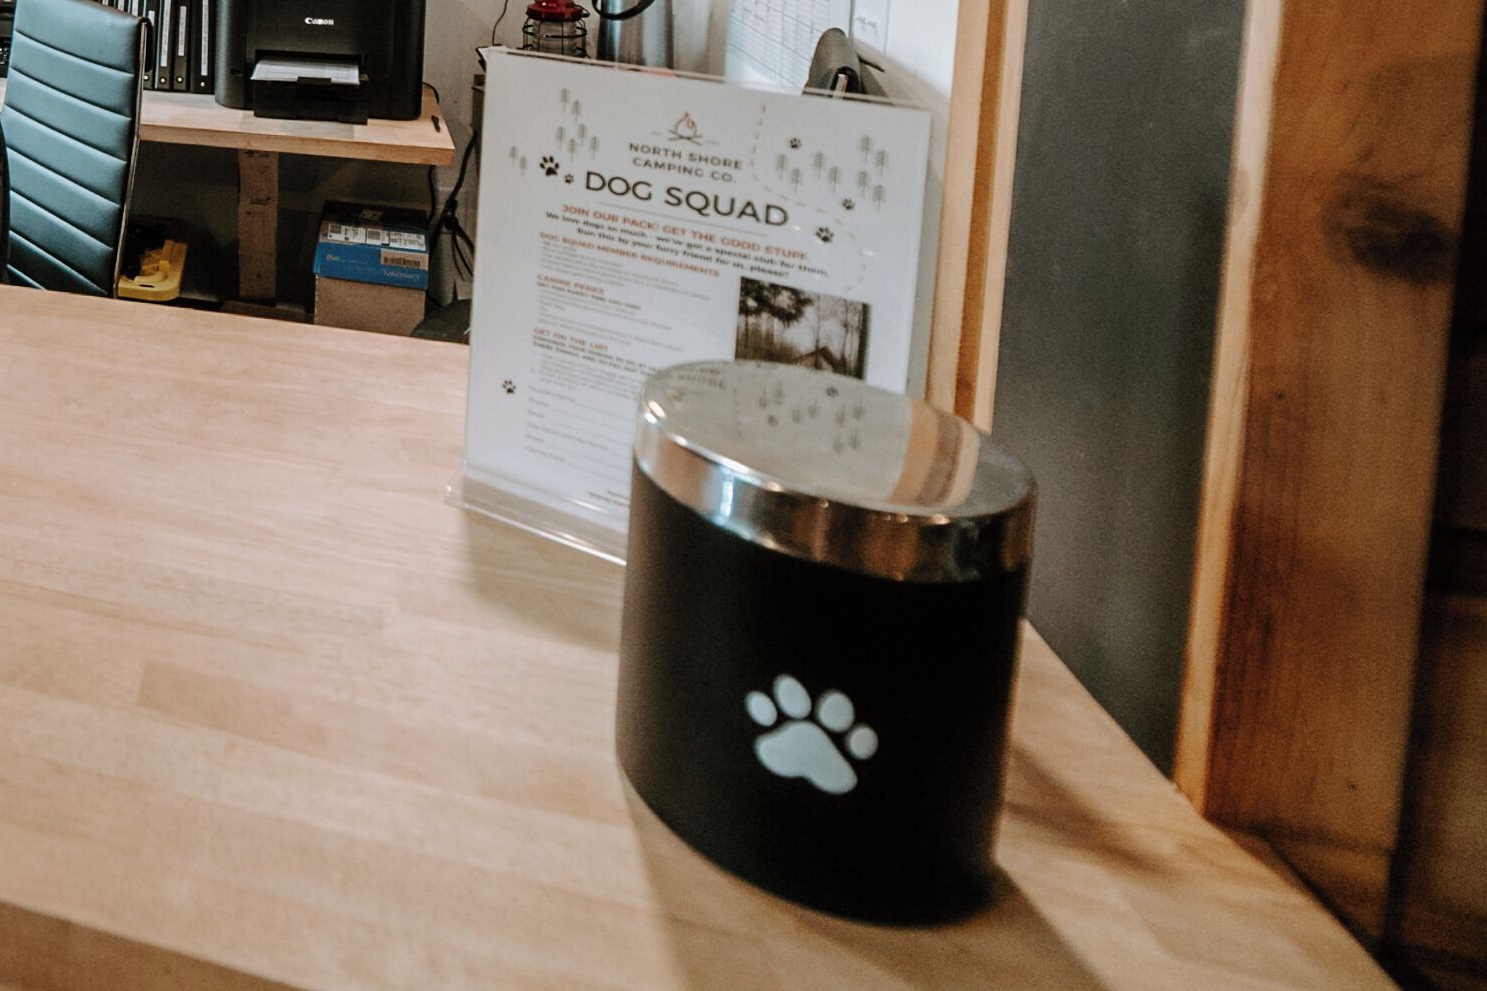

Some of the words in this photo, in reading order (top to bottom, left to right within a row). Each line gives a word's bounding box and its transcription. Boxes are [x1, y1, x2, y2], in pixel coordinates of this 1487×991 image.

[304, 17, 334, 26] Canon
[629, 142, 683, 160] NORTH
[688, 152, 744, 171] SHORE
[633, 157, 705, 178] CAMPING
[711, 170, 737, 184] CO.
[585, 171, 653, 202] DOG
[664, 186, 789, 227] SQUAD
[545, 211, 559, 219] We
[561, 215, 578, 223] love
[561, 204, 589, 216] JOIN
[592, 210, 619, 222] OUR
[661, 224, 686, 236] GET
[690, 229, 715, 242] THE
[720, 236, 761, 251] GOOD
[561, 236, 594, 249] SQUAD
[596, 243, 637, 259] MEMBER
